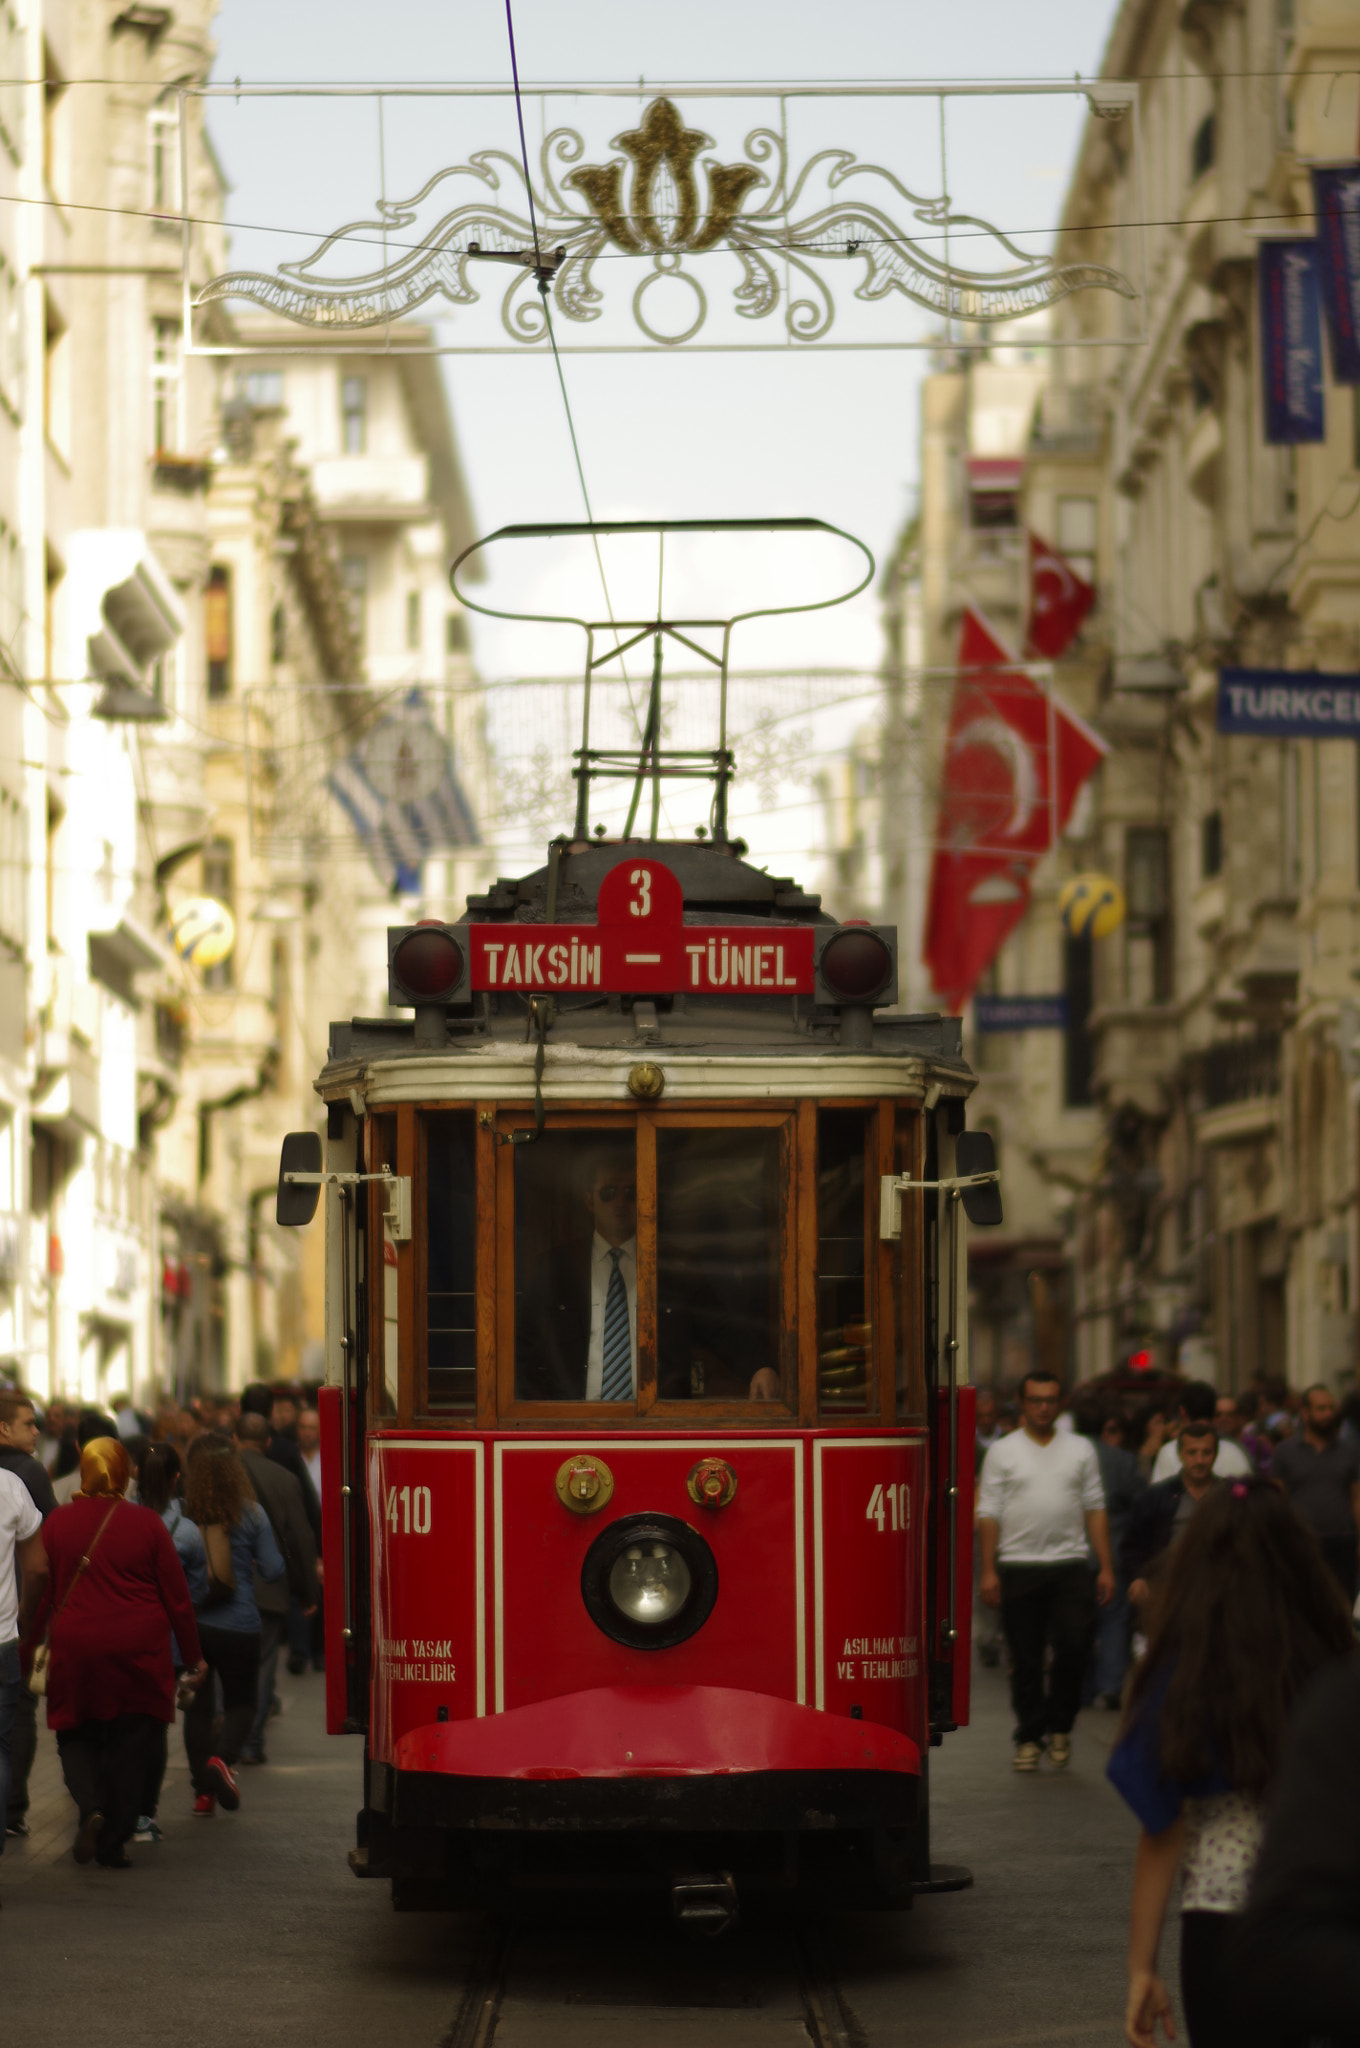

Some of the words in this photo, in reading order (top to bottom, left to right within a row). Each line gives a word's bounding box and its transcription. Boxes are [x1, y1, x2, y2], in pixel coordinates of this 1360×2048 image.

[630, 869, 651, 916] 3
[483, 936, 601, 985] TAKSİM
[686, 937, 797, 986] TÜNEL
[386, 1485, 431, 1534] 410
[865, 1482, 910, 1532] 410
[412, 1639, 452, 1658] YASAK
[837, 1661, 855, 1680] VE
